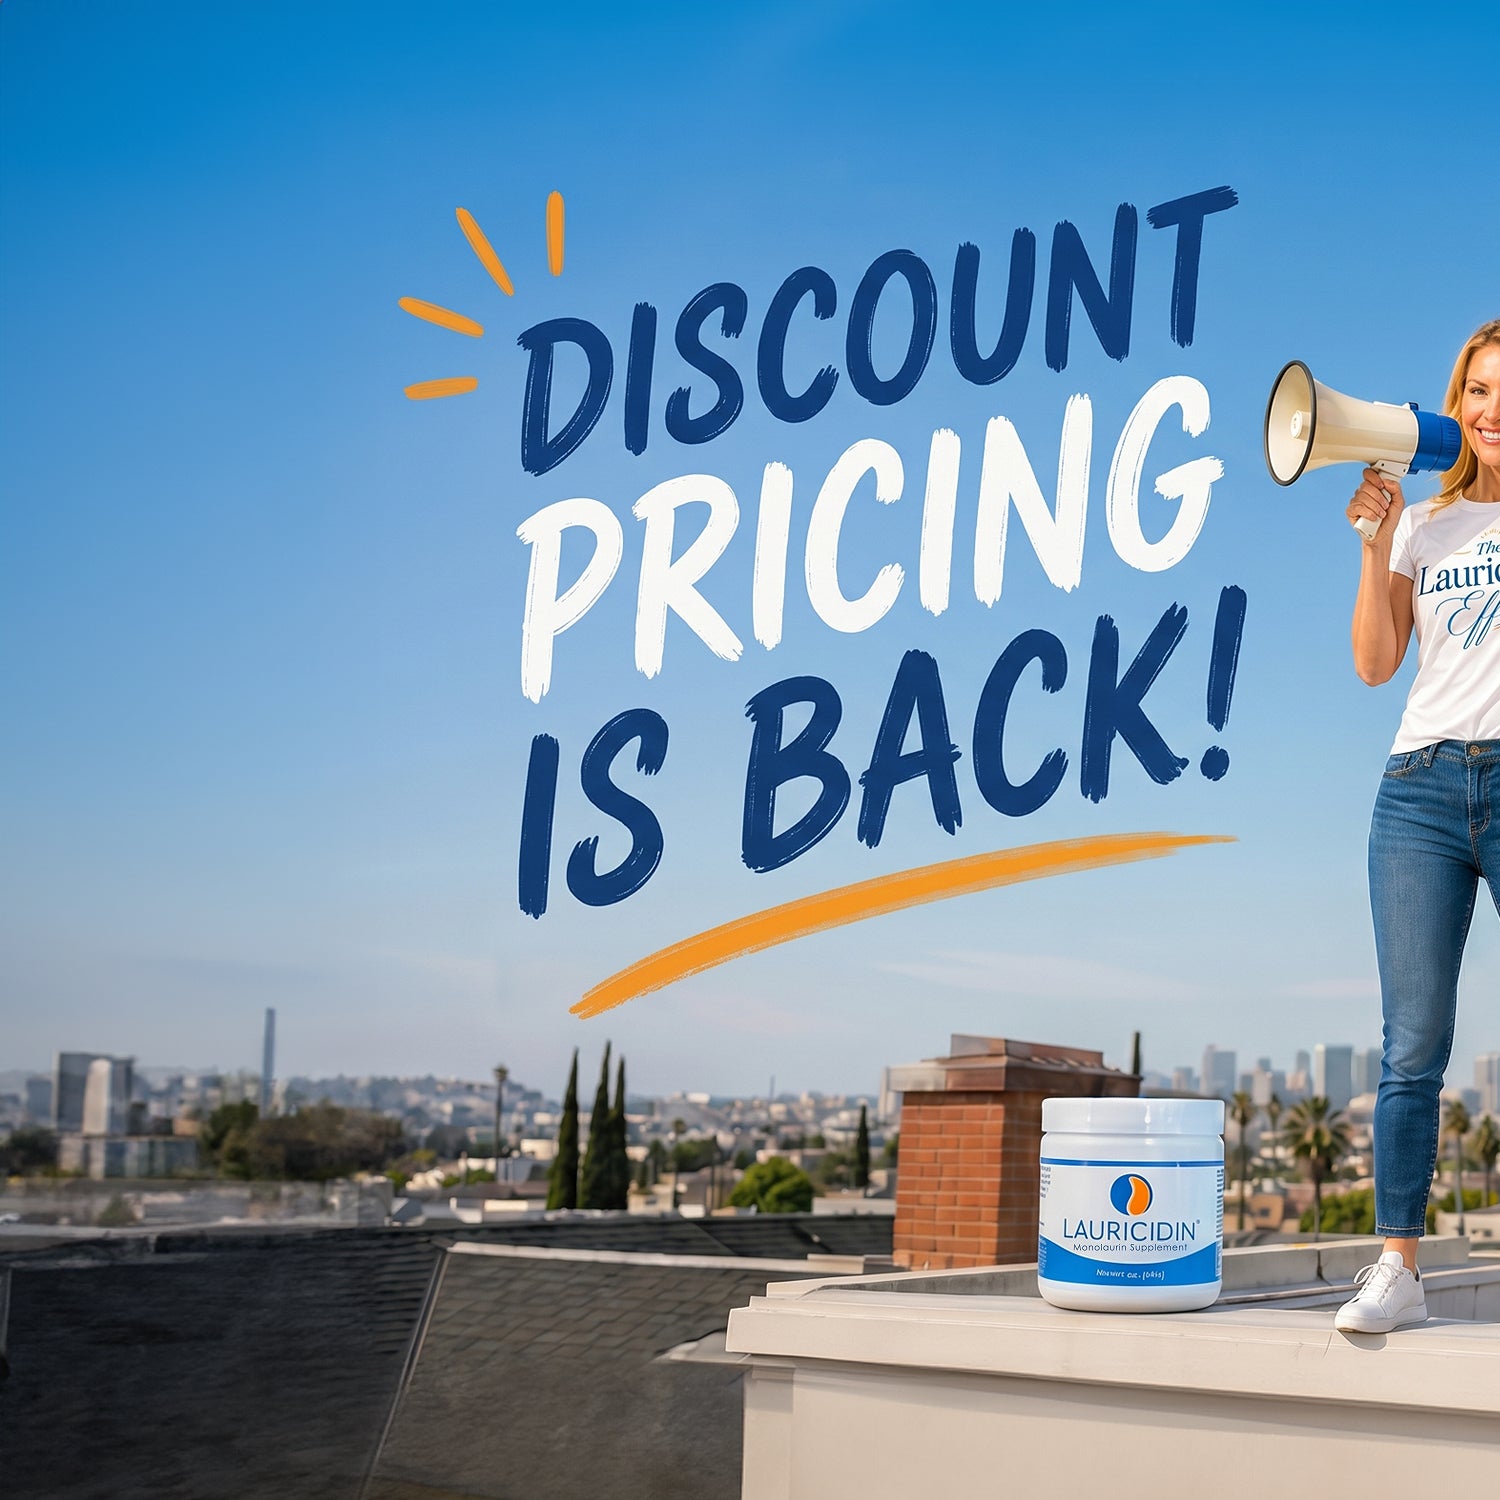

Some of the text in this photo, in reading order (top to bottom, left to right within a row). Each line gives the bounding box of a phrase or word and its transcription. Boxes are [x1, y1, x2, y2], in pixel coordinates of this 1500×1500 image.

[1063, 1218, 1195, 1242] LAURICIDIN
[1073, 1243, 1188, 1253] Monolaurin Supplement
